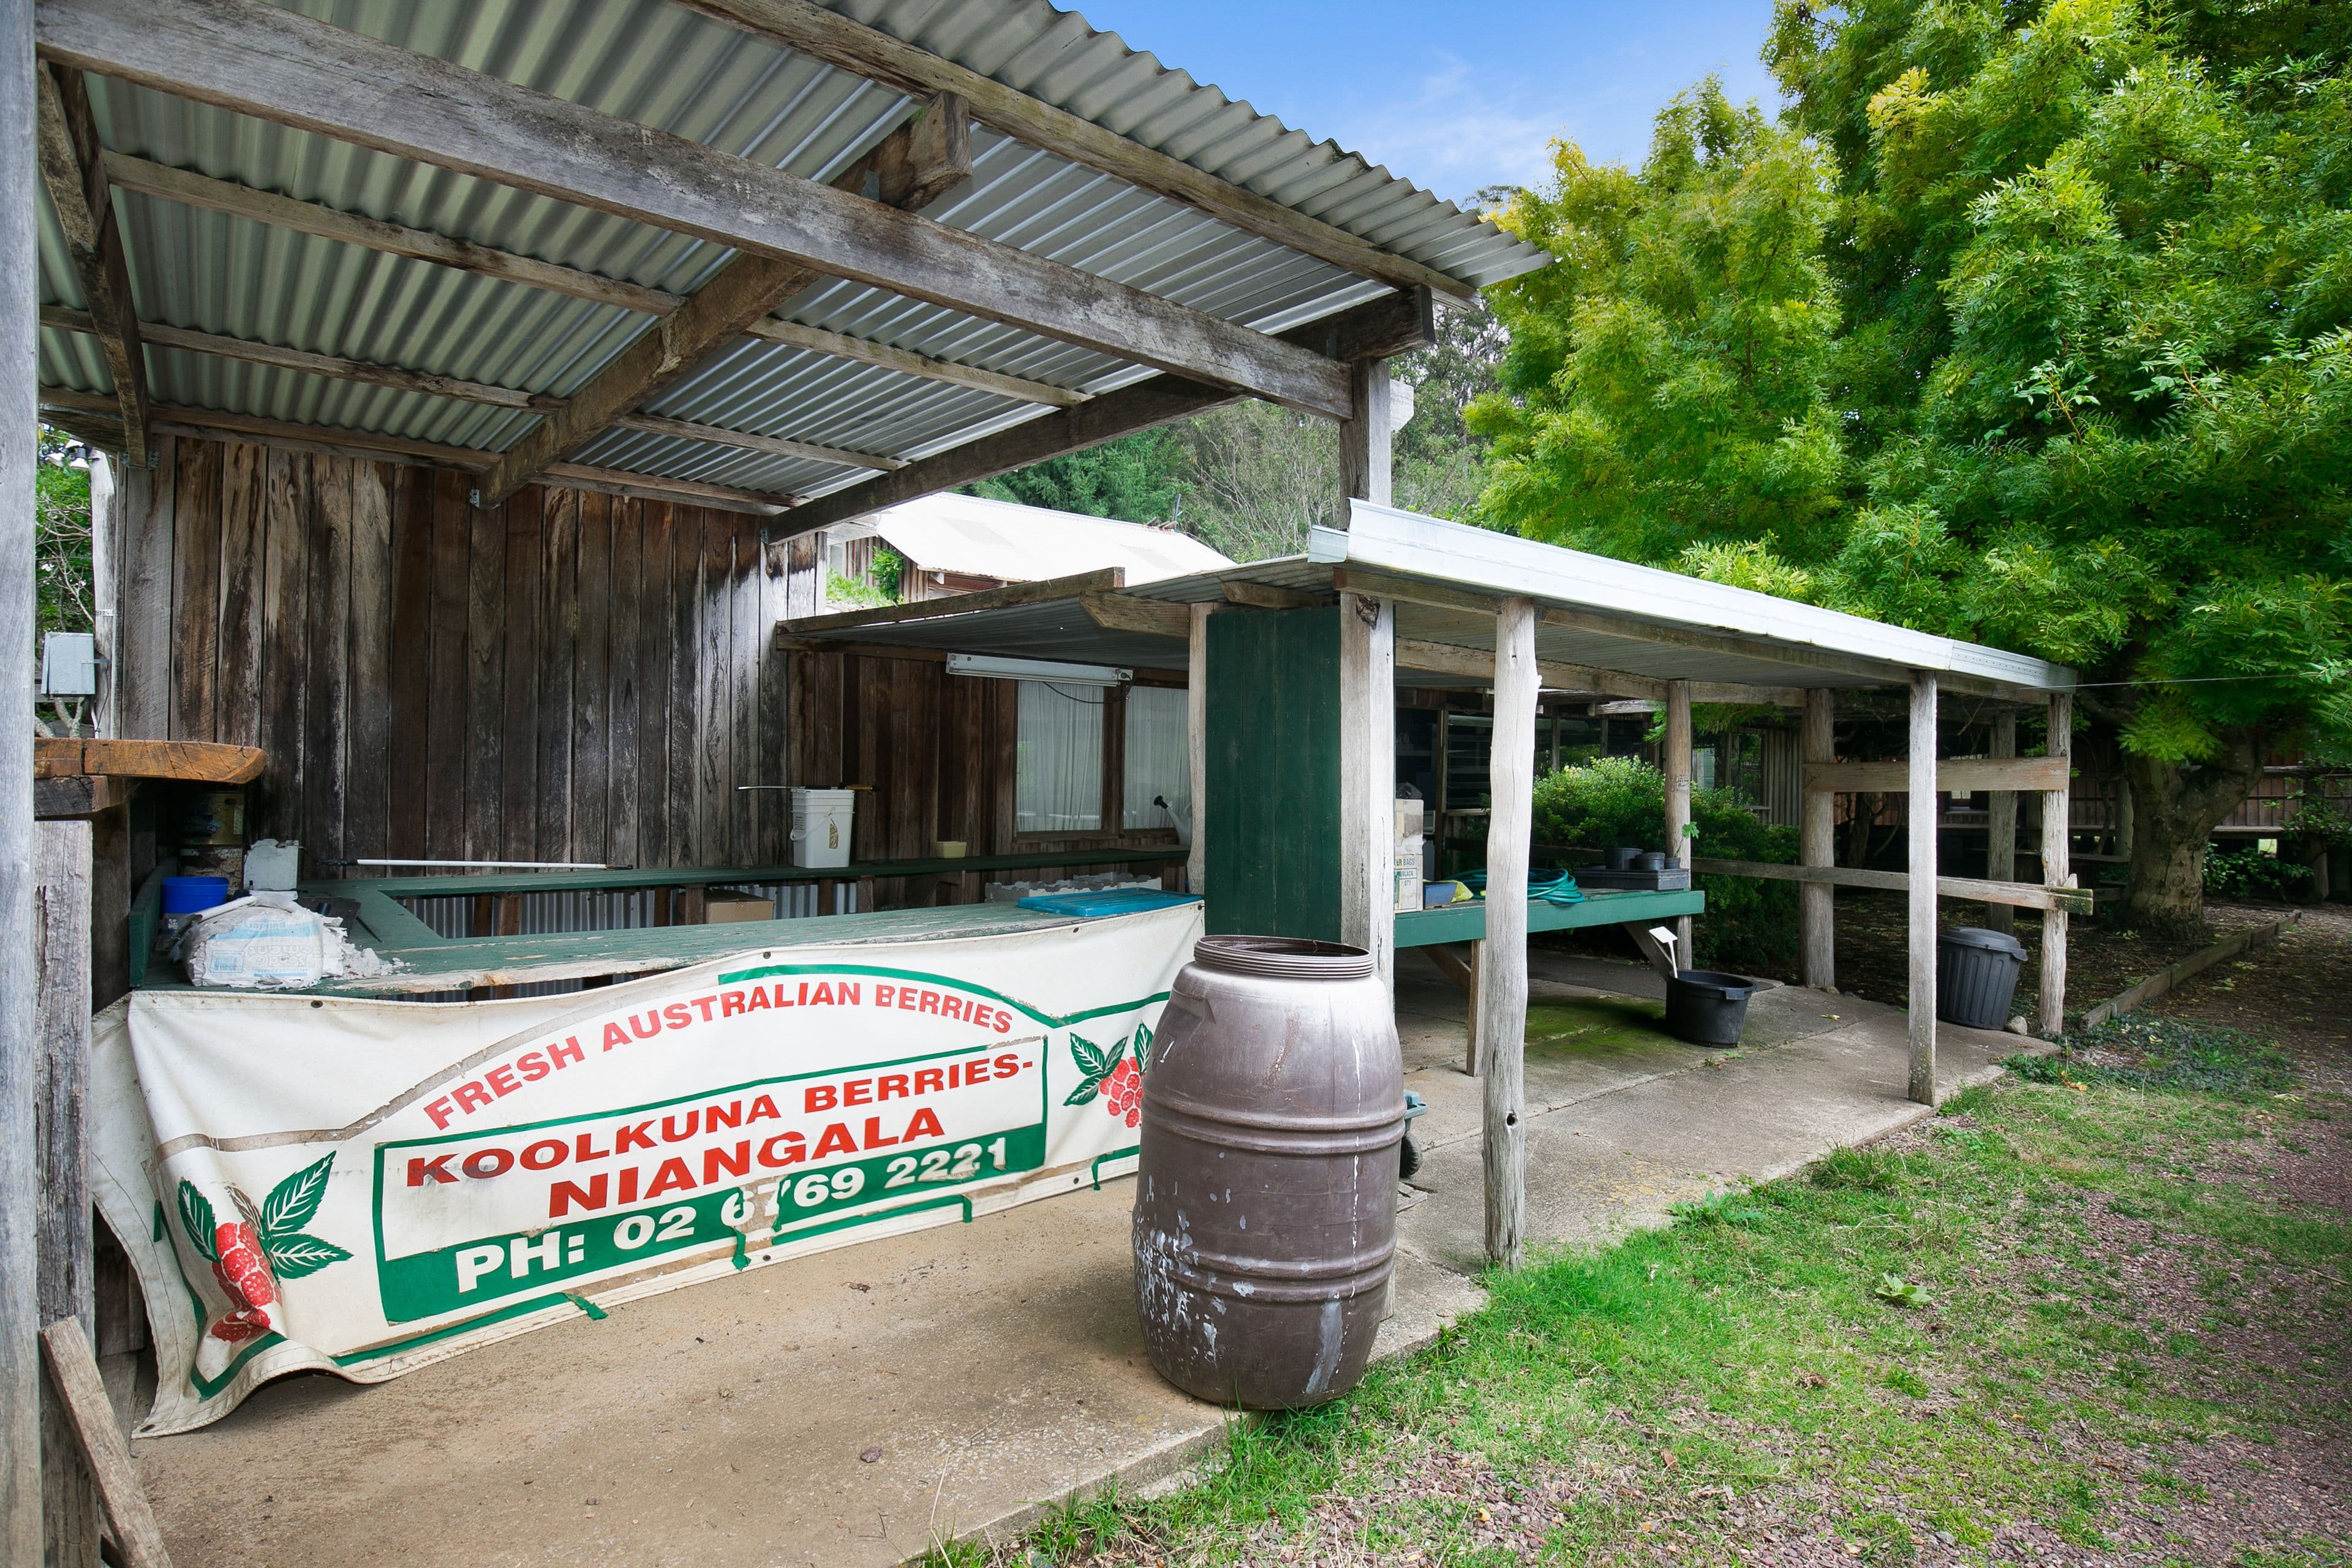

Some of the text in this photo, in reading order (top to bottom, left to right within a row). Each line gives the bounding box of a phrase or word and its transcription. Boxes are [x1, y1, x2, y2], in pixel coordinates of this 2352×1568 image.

[407, 1054, 1032, 1186] KOOLKUNA BERRIES-
[424, 982, 1012, 1129] FRESH AUSTRALIAN BERRIES
[455, 1231, 586, 1294] PH:
[614, 1207, 696, 1250] 02
[884, 1137, 1008, 1188] 2221
[549, 1108, 944, 1218] NIANGALA
